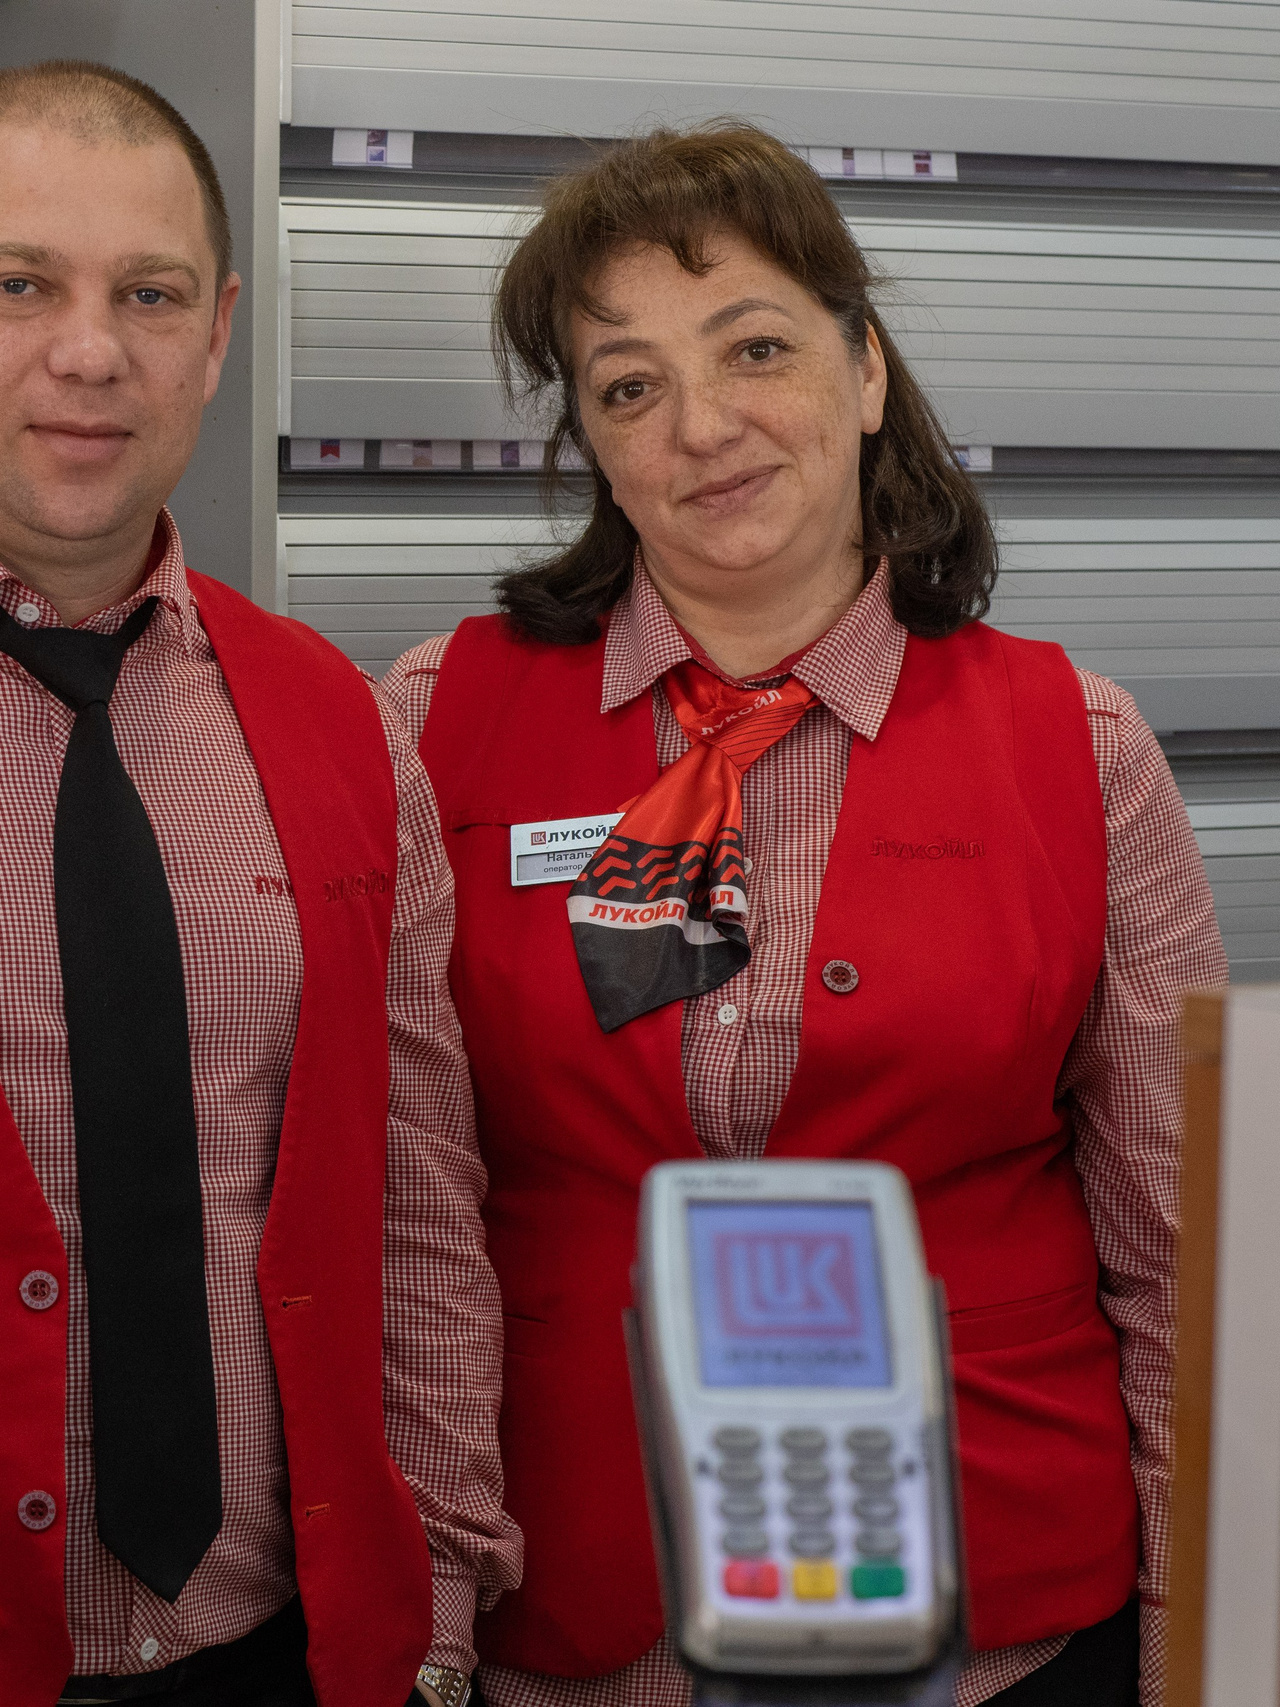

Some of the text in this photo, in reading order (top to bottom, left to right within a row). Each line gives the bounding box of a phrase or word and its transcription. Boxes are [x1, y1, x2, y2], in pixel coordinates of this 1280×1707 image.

[700, 689, 783, 736] ЛУКОЙЛ
[869, 835, 986, 860] ЛУКОЙЛ
[543, 864, 583, 874] оператор
[588, 900, 686, 924] ЛУКОЙЛ
